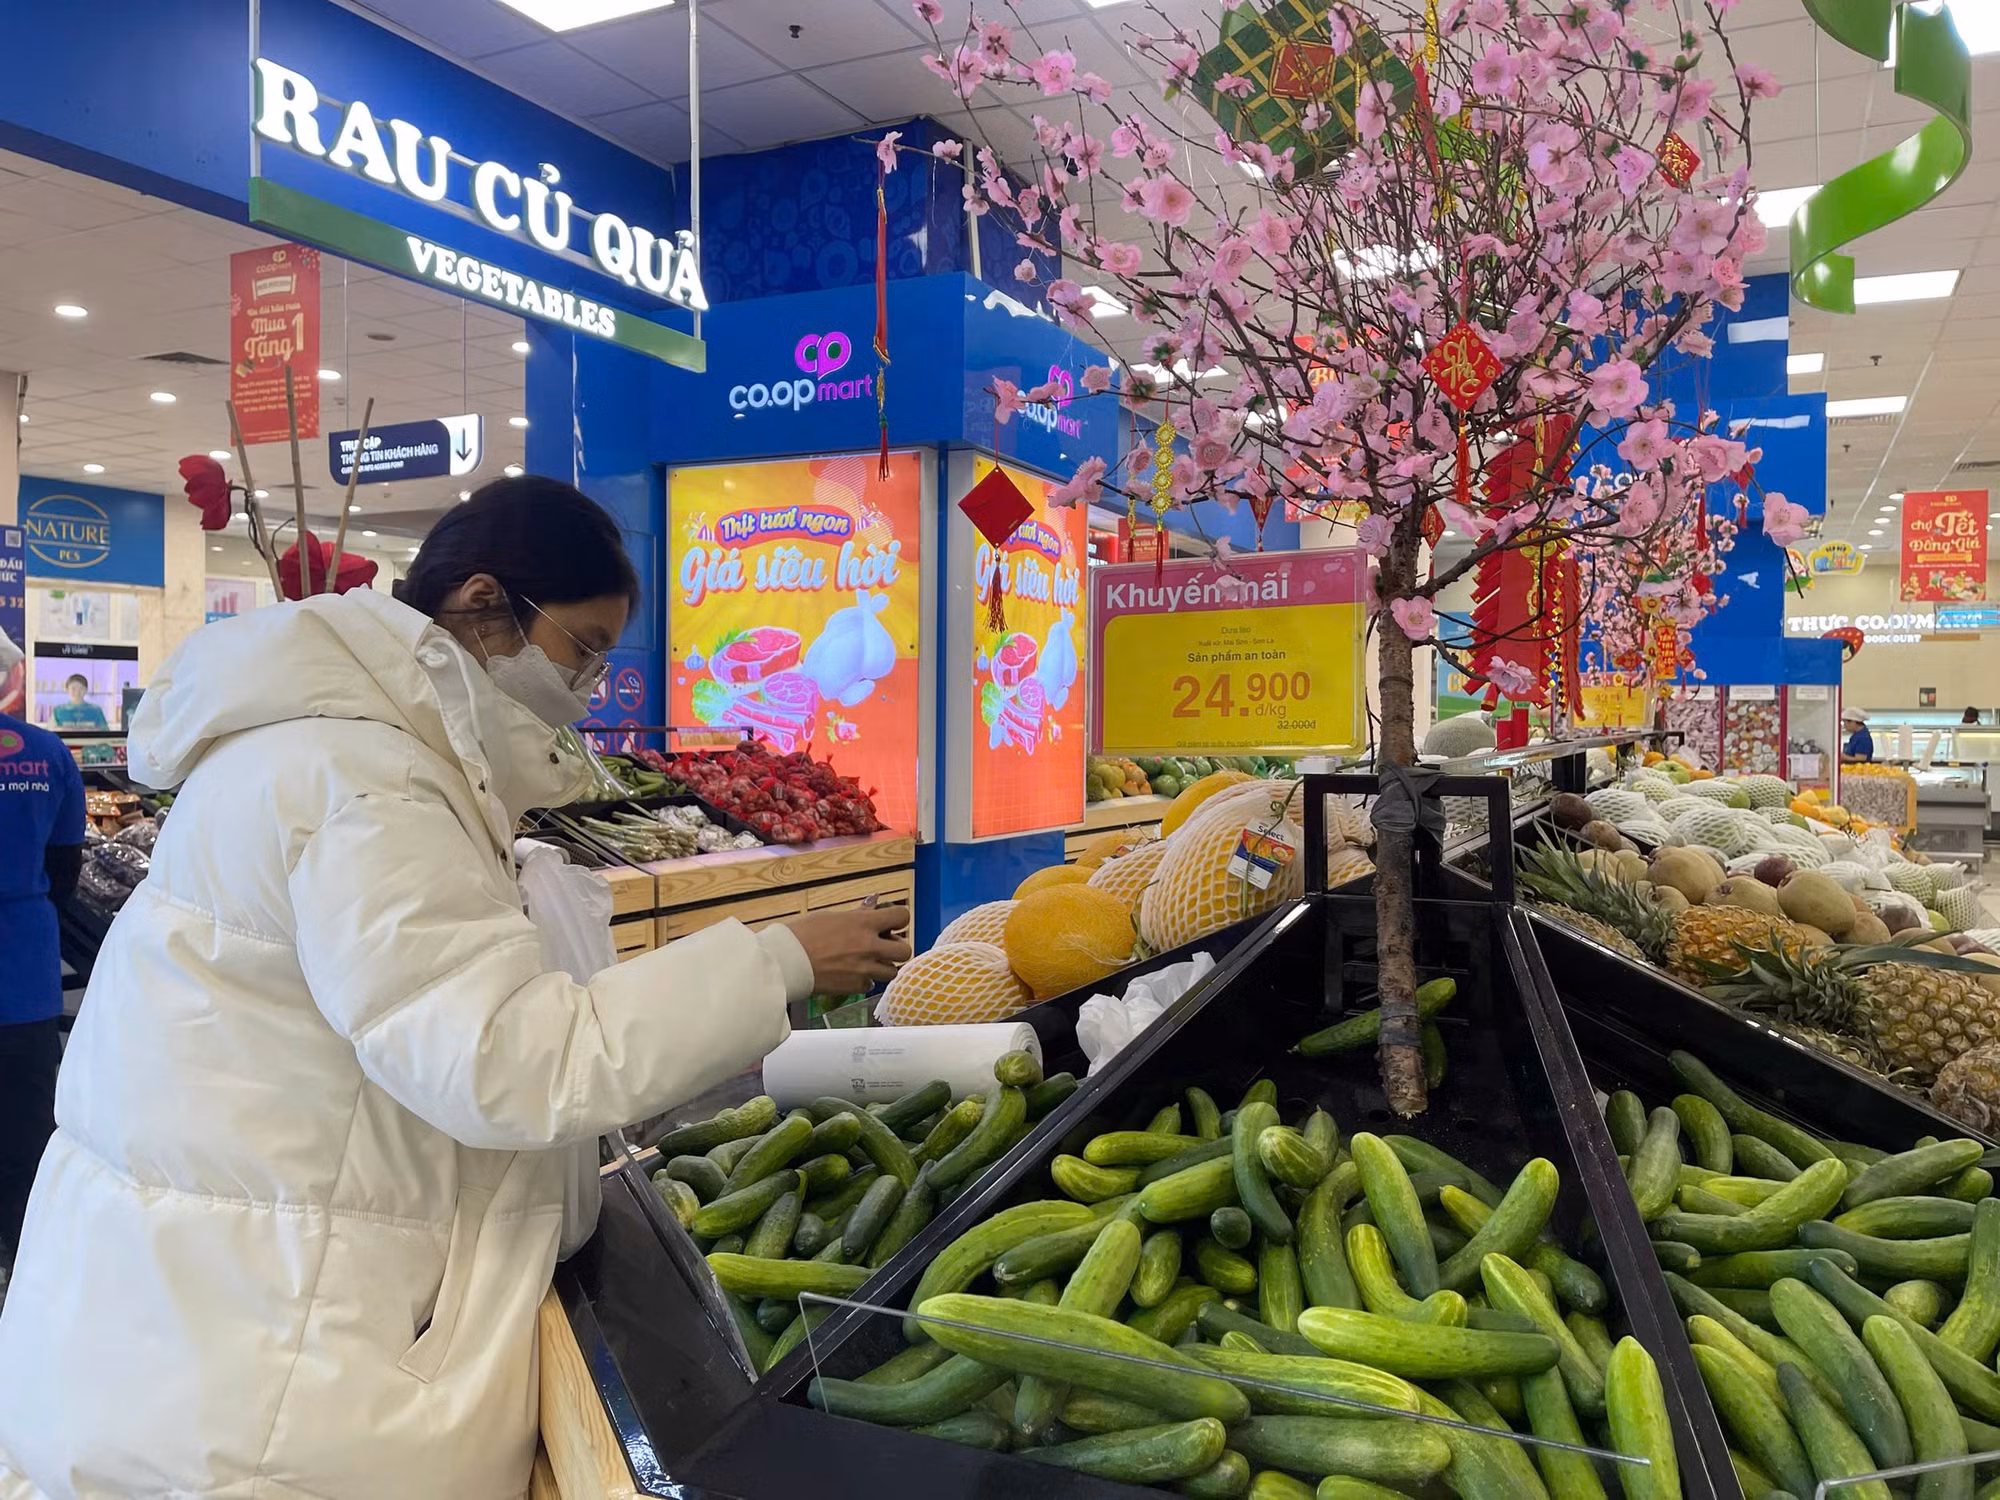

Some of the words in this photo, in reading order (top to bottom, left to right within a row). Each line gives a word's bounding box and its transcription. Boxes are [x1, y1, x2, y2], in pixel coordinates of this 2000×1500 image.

[256, 57, 452, 201] RAU
[474, 161, 573, 251] CỦ
[593, 213, 709, 310] QUẢ
[406, 236, 616, 338] VEGETABLES
[26, 519, 110, 544] NATURE
[799, 511, 849, 534] ngon
[1935, 510, 1979, 537] Tết
[680, 546, 747, 605] Giá
[754, 545, 828, 592] siêu
[836, 539, 902, 590] hời
[1106, 573, 1221, 613] Khuyến
[1245, 652, 1258, 661] an
[1261, 649, 1286, 660] toàn
[1257, 826, 1284, 841] Select
